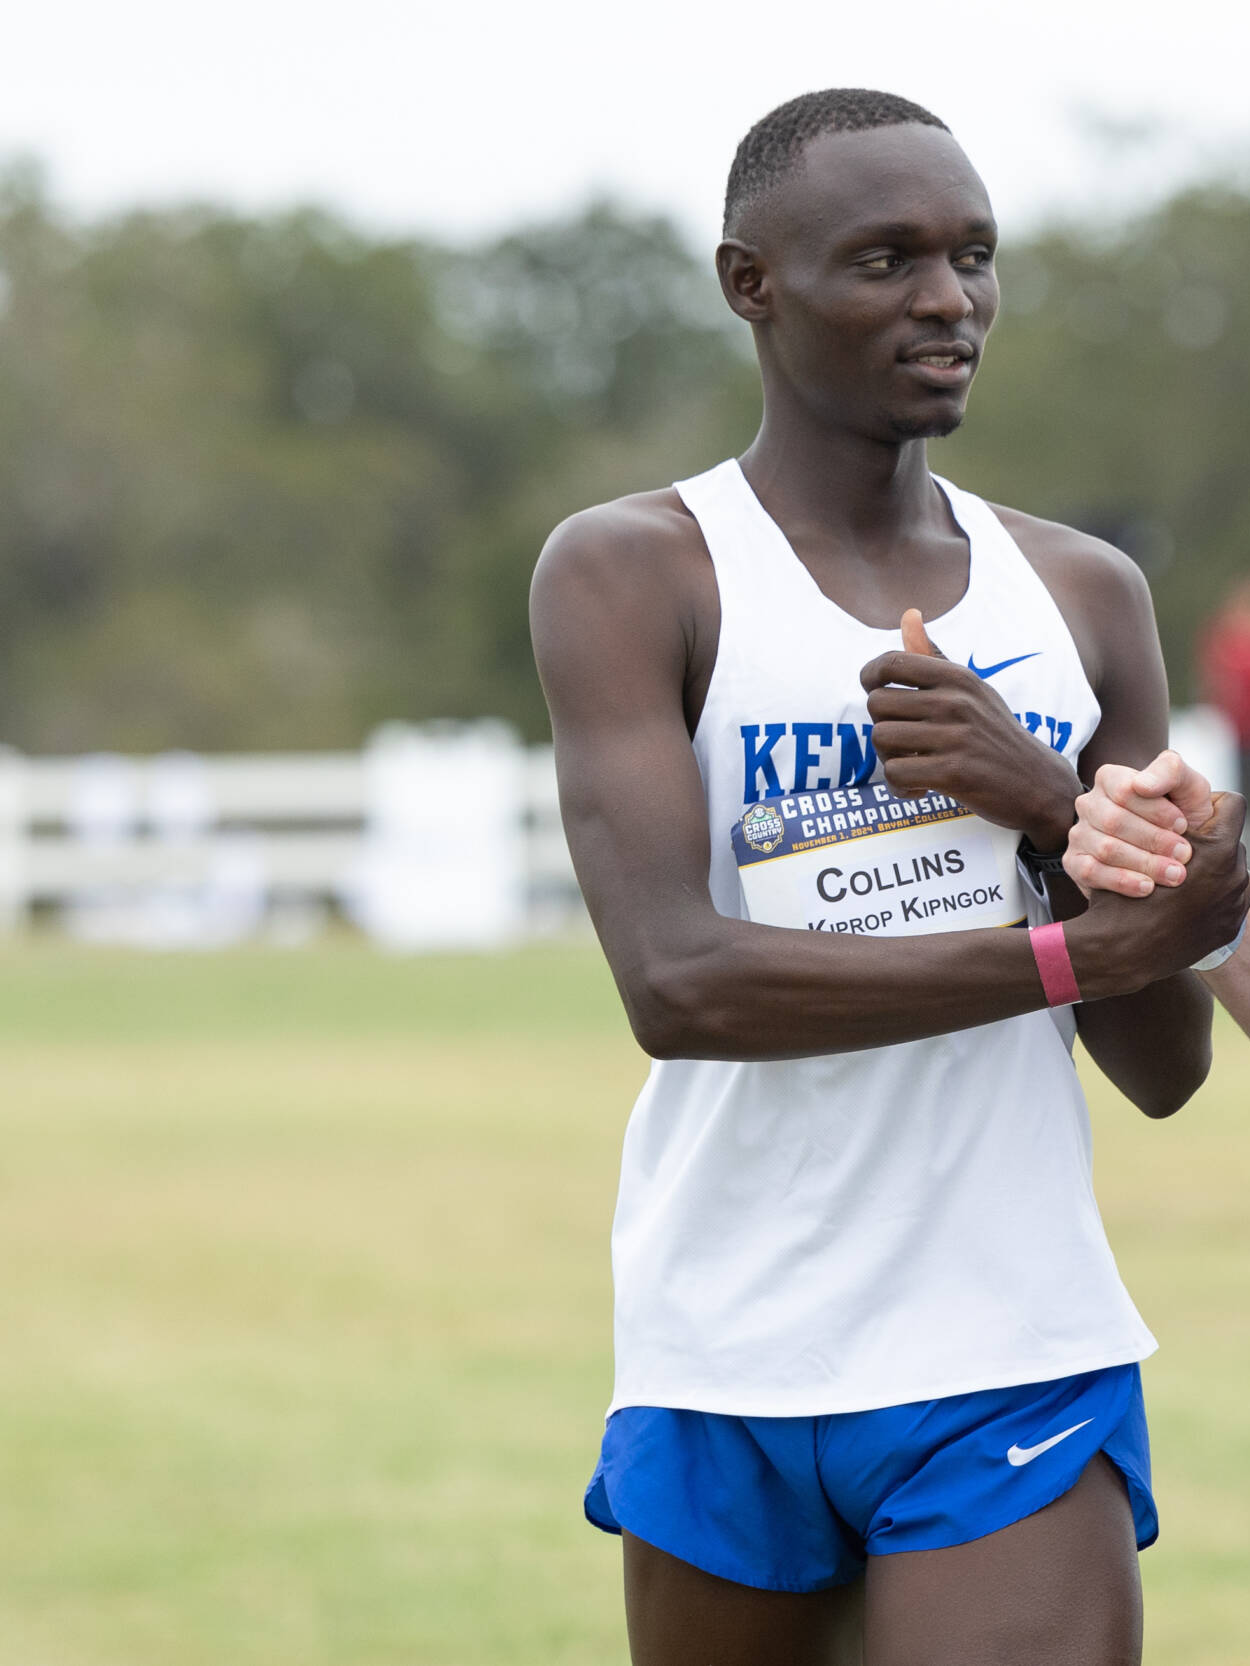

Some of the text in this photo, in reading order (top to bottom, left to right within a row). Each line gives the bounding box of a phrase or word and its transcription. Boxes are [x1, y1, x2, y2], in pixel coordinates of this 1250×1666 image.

[781, 787, 863, 820] CROSS
[801, 795, 957, 838] CHAMPIONSHI
[745, 818, 780, 834] CROSS
[747, 828, 782, 841] COUNTRY
[792, 834, 837, 852] NOVEMBER
[840, 831, 849, 842] 1,
[854, 825, 873, 837] 2024
[816, 848, 965, 903] COLLINS
[900, 884, 1004, 922] KIPNGOK
